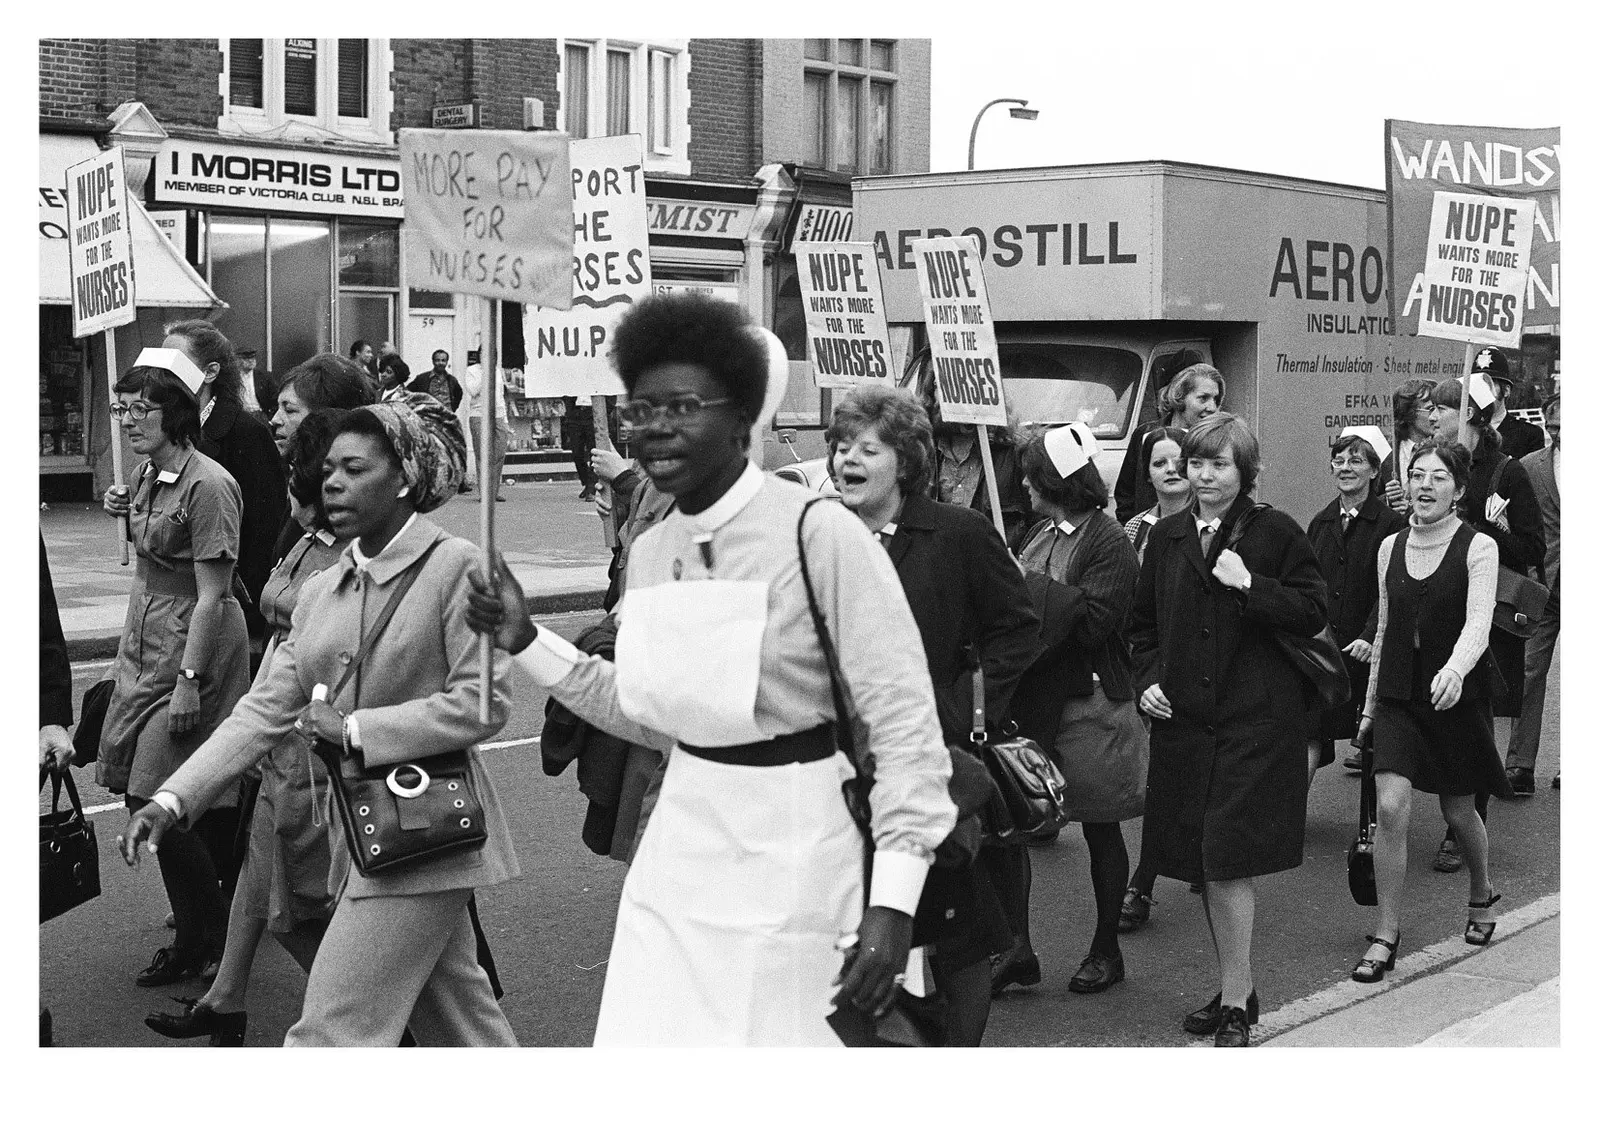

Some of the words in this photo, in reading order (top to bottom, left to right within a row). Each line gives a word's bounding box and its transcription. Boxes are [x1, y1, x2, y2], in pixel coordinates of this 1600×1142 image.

[435, 116, 467, 126] SURGERY
[437, 107, 463, 117] DENTAL
[171, 151, 178, 175] I
[191, 153, 331, 187] MORRIS
[342, 166, 400, 192] LTD
[413, 150, 478, 200] MORE
[497, 151, 552, 200] PAY
[77, 161, 116, 221] NUPE
[164, 180, 225, 194] MEMBER
[228, 185, 246, 195] OF
[249, 187, 308, 201] VICTORIA
[76, 220, 100, 246] WANTS
[102, 211, 121, 236] MORE
[463, 205, 504, 241] FOR
[647, 203, 739, 233] MIST
[1445, 201, 1518, 247] NUPE
[86, 246, 99, 267] FOR
[101, 240, 113, 262] THE
[430, 249, 524, 289] NURSES
[1438, 243, 1480, 264] WANTS
[1485, 249, 1519, 269] MORE
[808, 253, 868, 292] NUPE
[923, 249, 976, 299] NUPE
[1269, 237, 1388, 304] AERO
[1451, 265, 1474, 284] FOR
[1479, 269, 1500, 288] THE
[77, 261, 128, 321] NURSES
[810, 296, 844, 313] WANTS
[847, 297, 875, 314] MORE
[422, 317, 434, 328] 59
[931, 304, 958, 325] WANTS
[961, 304, 984, 325] MORE
[1426, 283, 1517, 333] NURSES
[825, 317, 844, 334] FOR
[847, 318, 866, 334] THE
[943, 331, 959, 351] FOR
[960, 331, 977, 351] THE
[813, 337, 887, 378] NURSES
[1276, 353, 1320, 373] Thermal
[1322, 354, 1373, 373] Insulation
[1384, 356, 1411, 374] Sheet
[1415, 358, 1441, 374] metal
[935, 357, 999, 406] NURSES
[1345, 394, 1379, 408] EFKA
